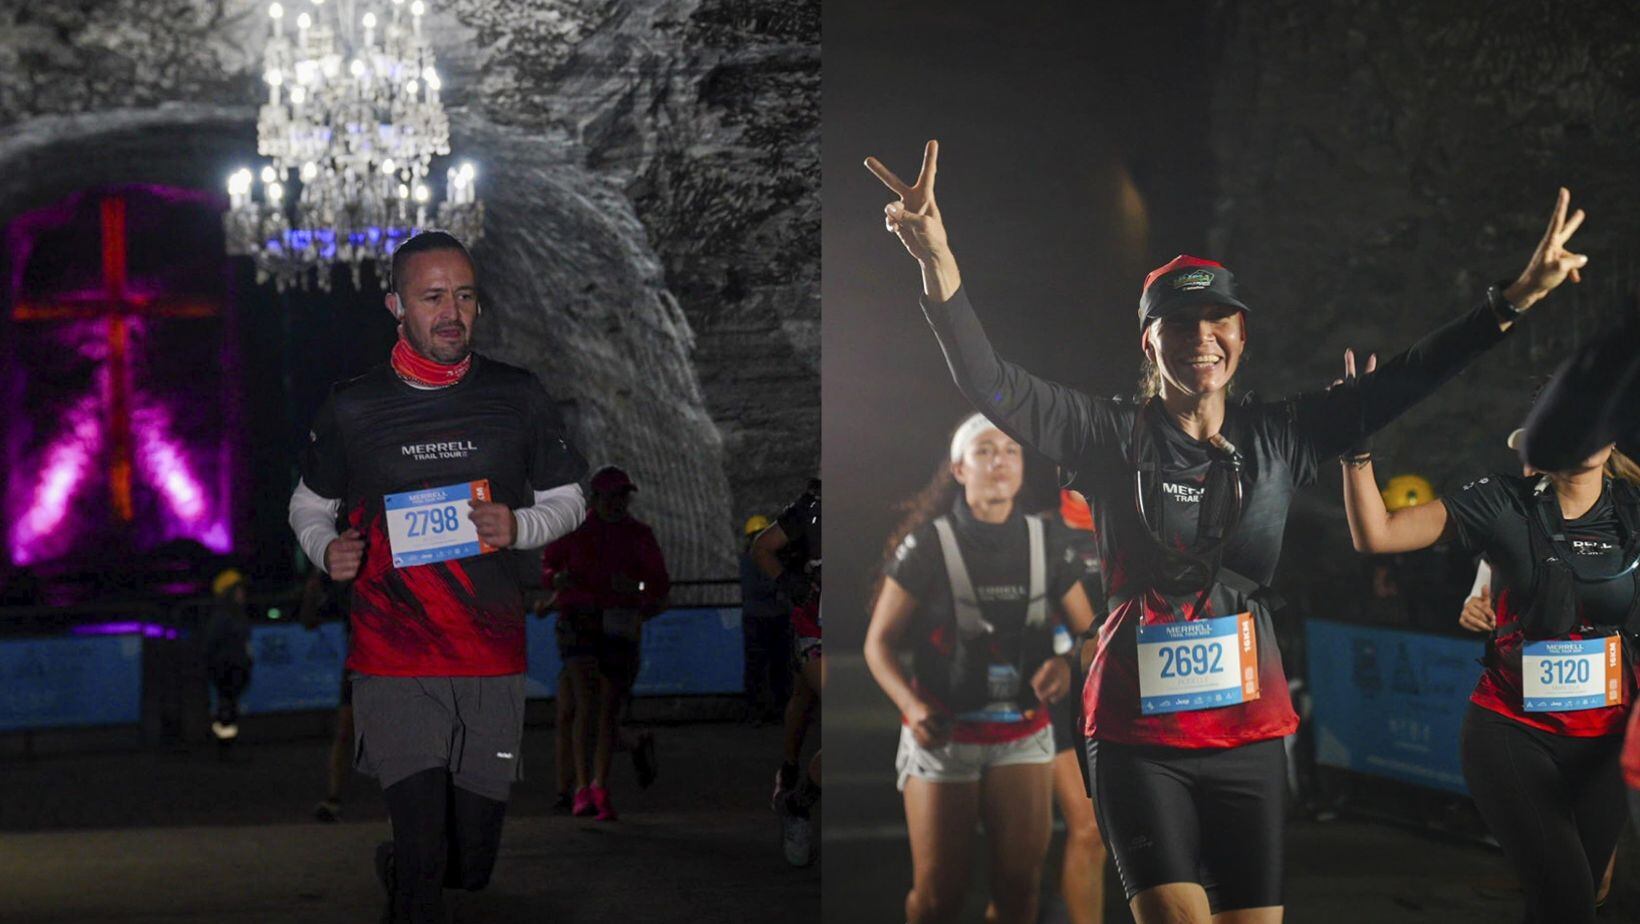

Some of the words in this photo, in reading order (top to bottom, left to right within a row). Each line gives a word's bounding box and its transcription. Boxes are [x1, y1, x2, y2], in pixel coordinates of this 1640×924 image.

[402, 441, 477, 455] MERRELL
[408, 491, 448, 501] MERRELL
[405, 505, 459, 537] 2798
[1166, 624, 1212, 634] MERRELL
[1242, 621, 1251, 652] 16KM
[1159, 642, 1223, 678] 2692
[1609, 643, 1617, 667] 16KM
[1540, 659, 1589, 684] 3120
